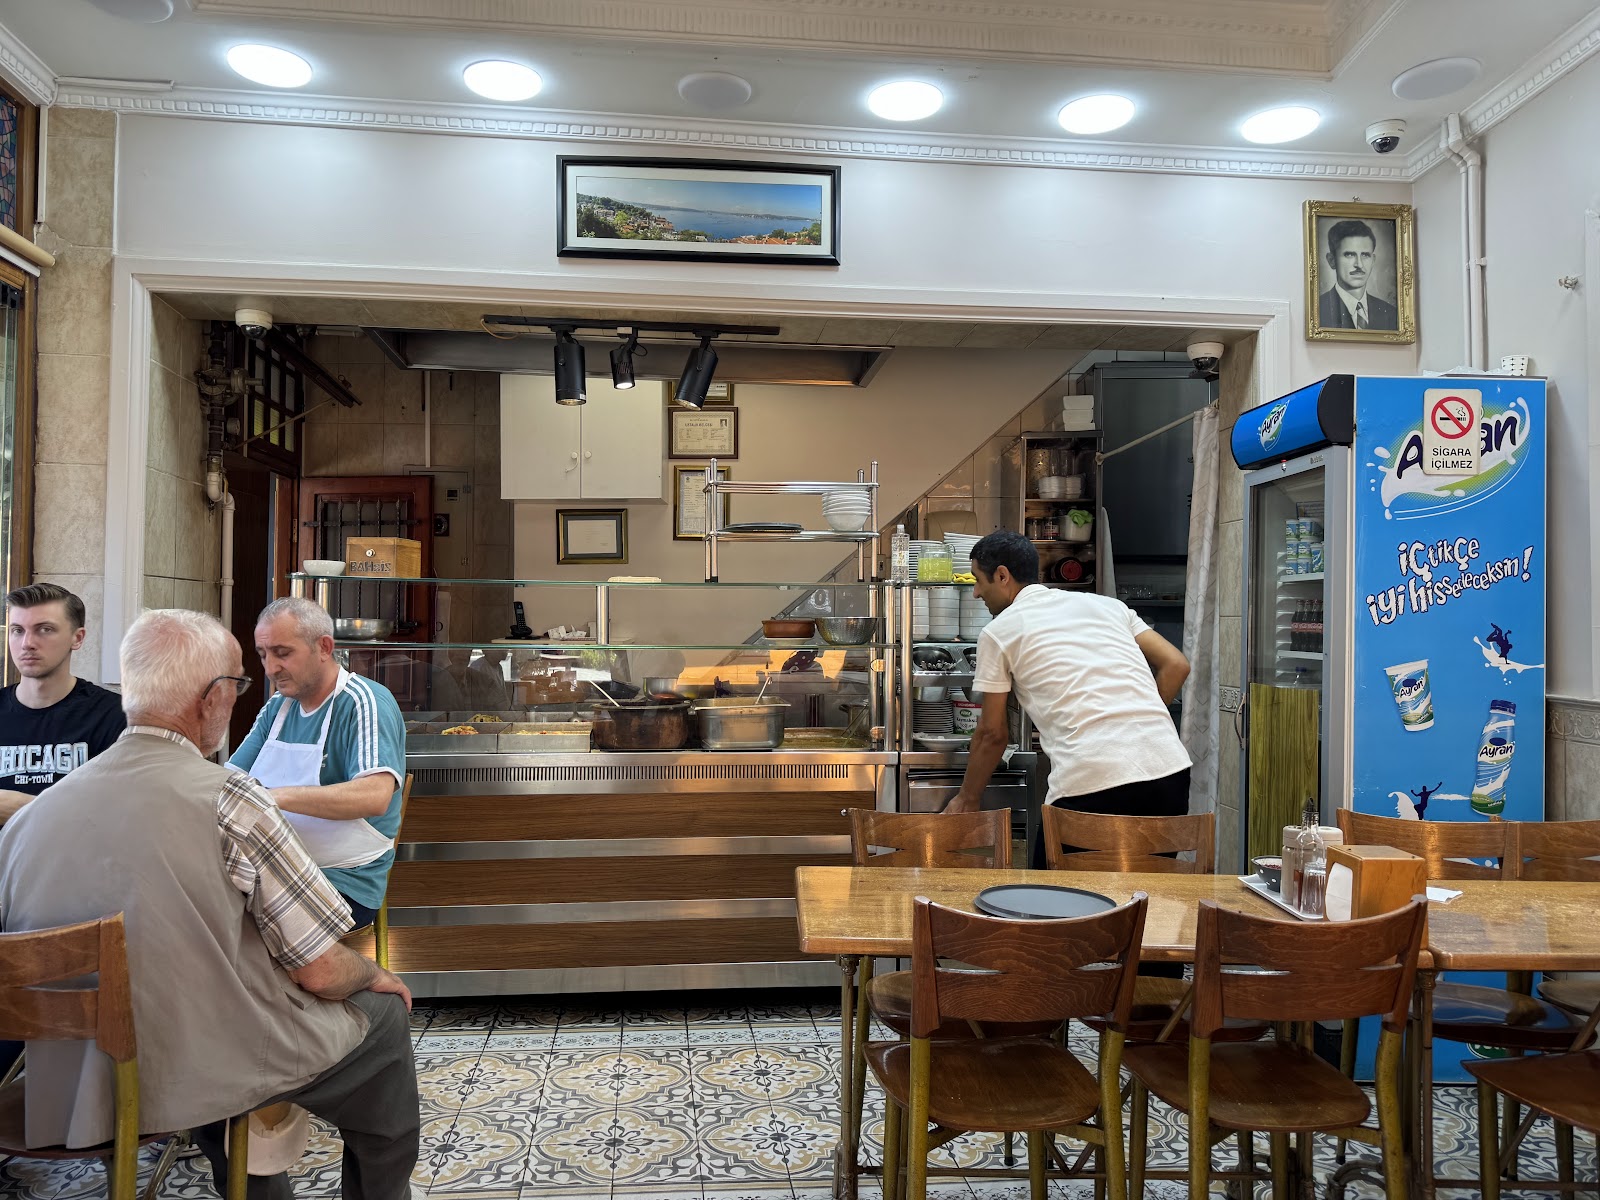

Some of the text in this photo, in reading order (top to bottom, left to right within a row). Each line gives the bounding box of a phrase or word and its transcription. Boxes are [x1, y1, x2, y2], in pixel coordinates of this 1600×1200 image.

[1261, 406, 1286, 438] Ayran
[1396, 415, 1518, 480] Aan
[1432, 445, 1472, 457] SİGARA
[1431, 458, 1473, 470] İÇİLMEZ
[1366, 585, 1406, 626] iyi
[1399, 680, 1424, 698] Ayran
[0, 742, 88, 778] HICAGO
[1479, 744, 1513, 758] Ayran
[14, 773, 54, 785] CHI-TOWN
